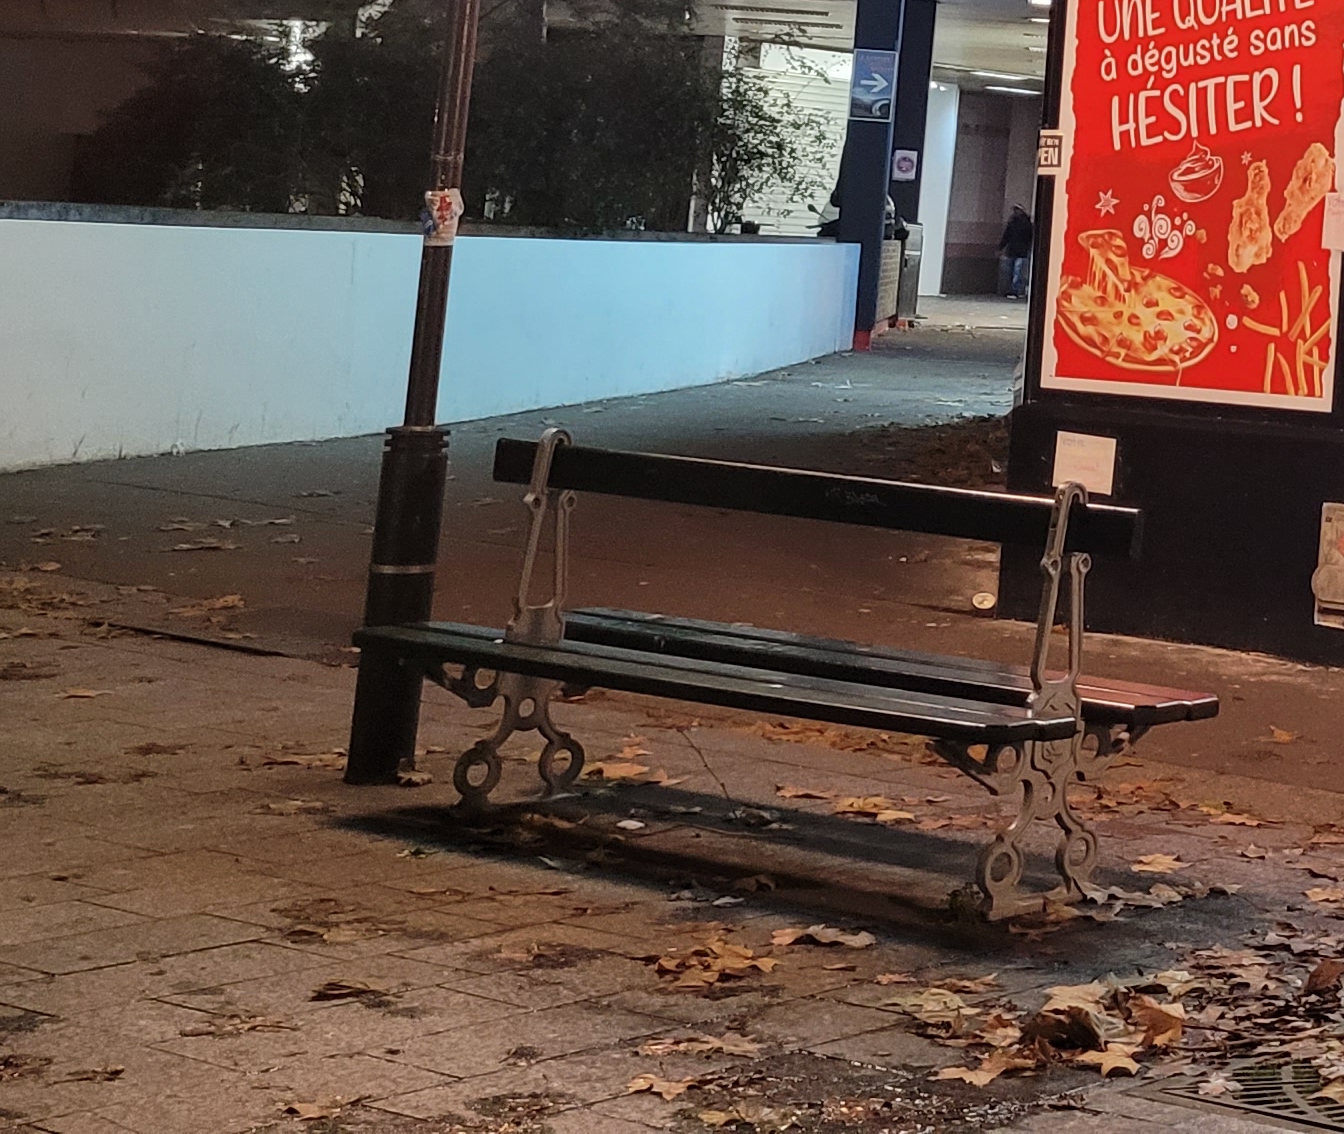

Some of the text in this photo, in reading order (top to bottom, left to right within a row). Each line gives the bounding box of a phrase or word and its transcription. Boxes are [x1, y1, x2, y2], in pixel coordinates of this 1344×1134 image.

[1101, 21, 1317, 81] à dégusté sans
[1111, 64, 1303, 151] HÉSITER !
